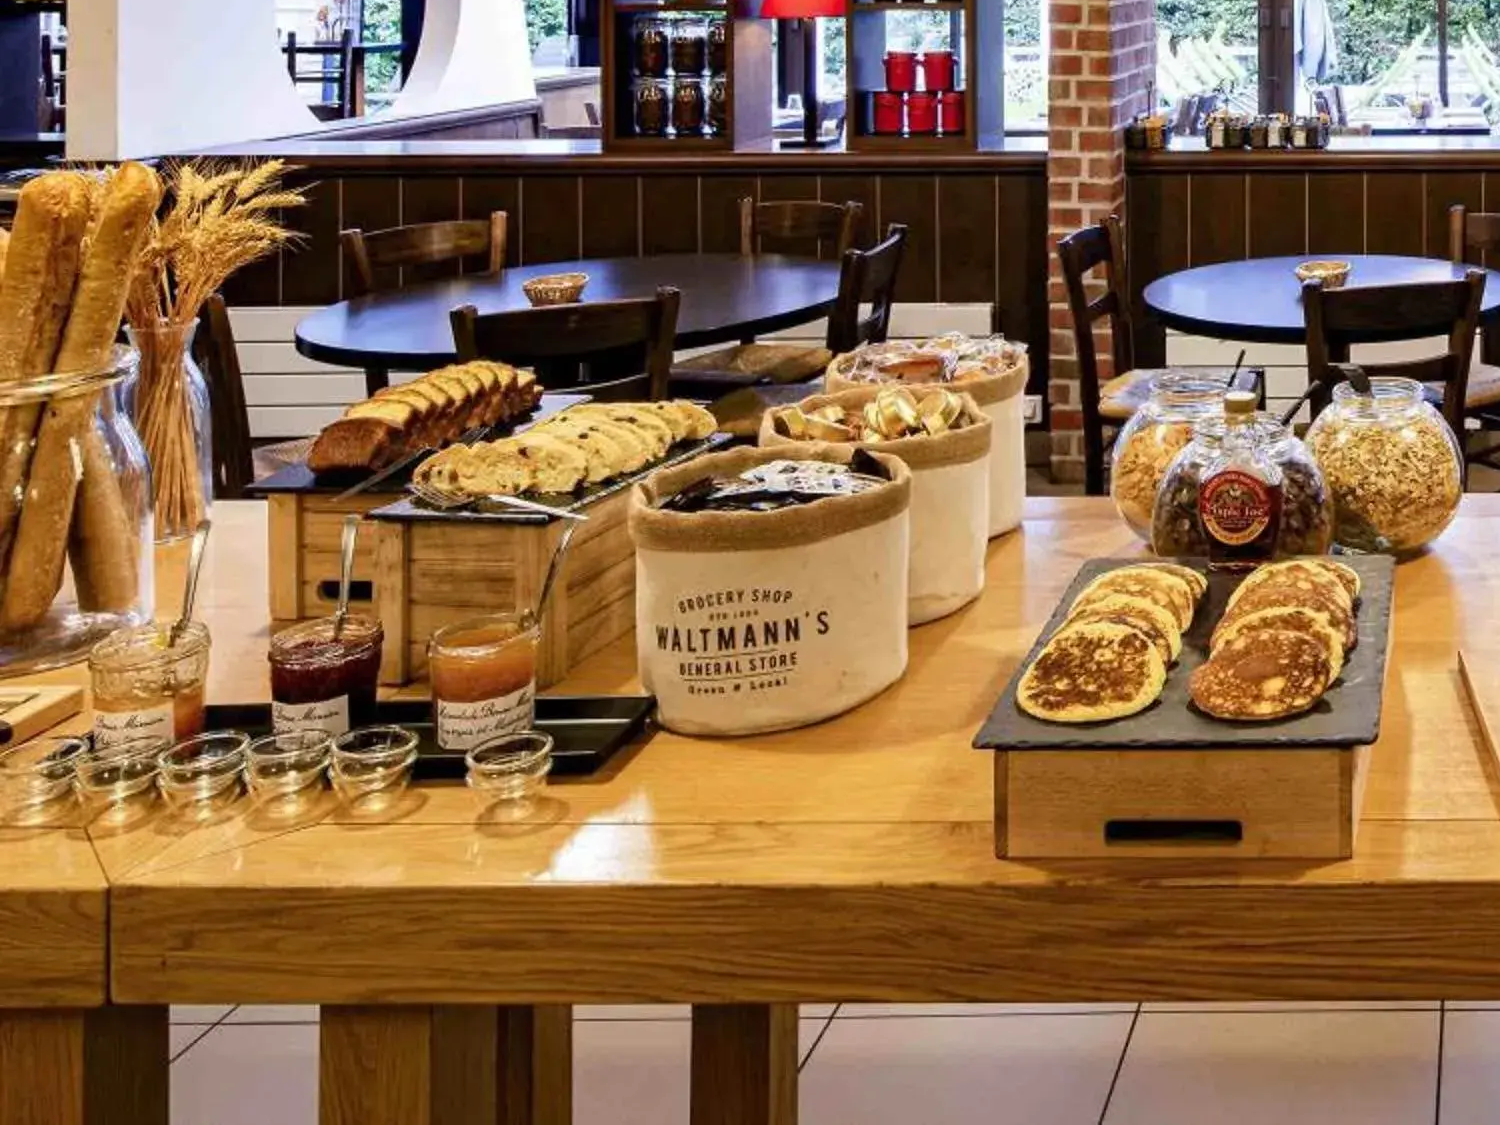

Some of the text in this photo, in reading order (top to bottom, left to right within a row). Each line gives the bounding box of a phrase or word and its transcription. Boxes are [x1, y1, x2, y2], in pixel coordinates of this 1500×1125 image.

[678, 589, 793, 613] GROCERY SHOP
[656, 611, 830, 652] WALTMANN'S
[679, 651, 798, 676] GENERAL STORE
